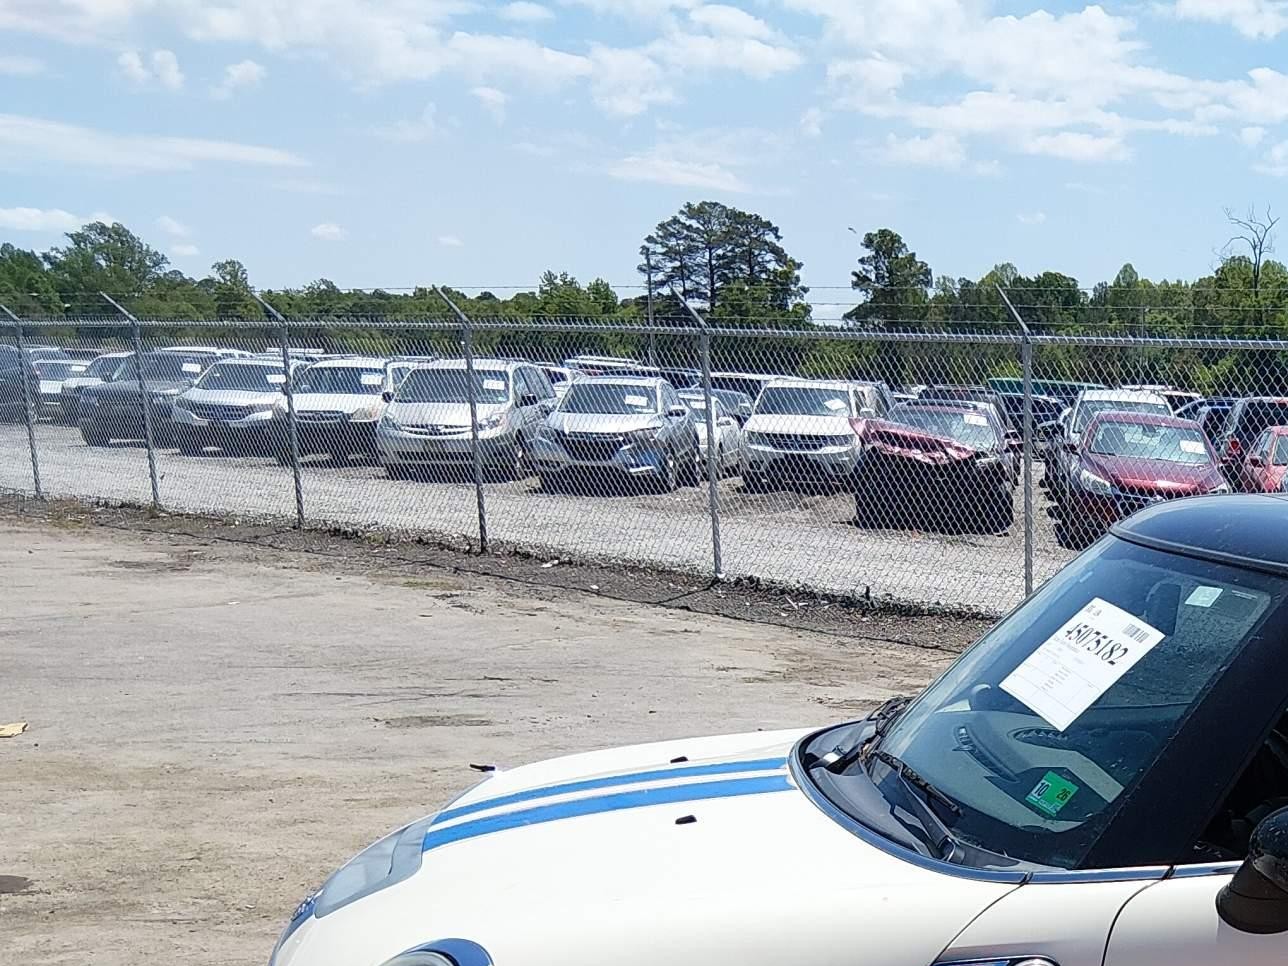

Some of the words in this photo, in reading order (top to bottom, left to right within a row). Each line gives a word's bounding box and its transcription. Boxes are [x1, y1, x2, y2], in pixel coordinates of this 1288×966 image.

[1065, 622, 1129, 666] 45075182
[1034, 782, 1050, 797] 10
[1056, 788, 1071, 801] 26
